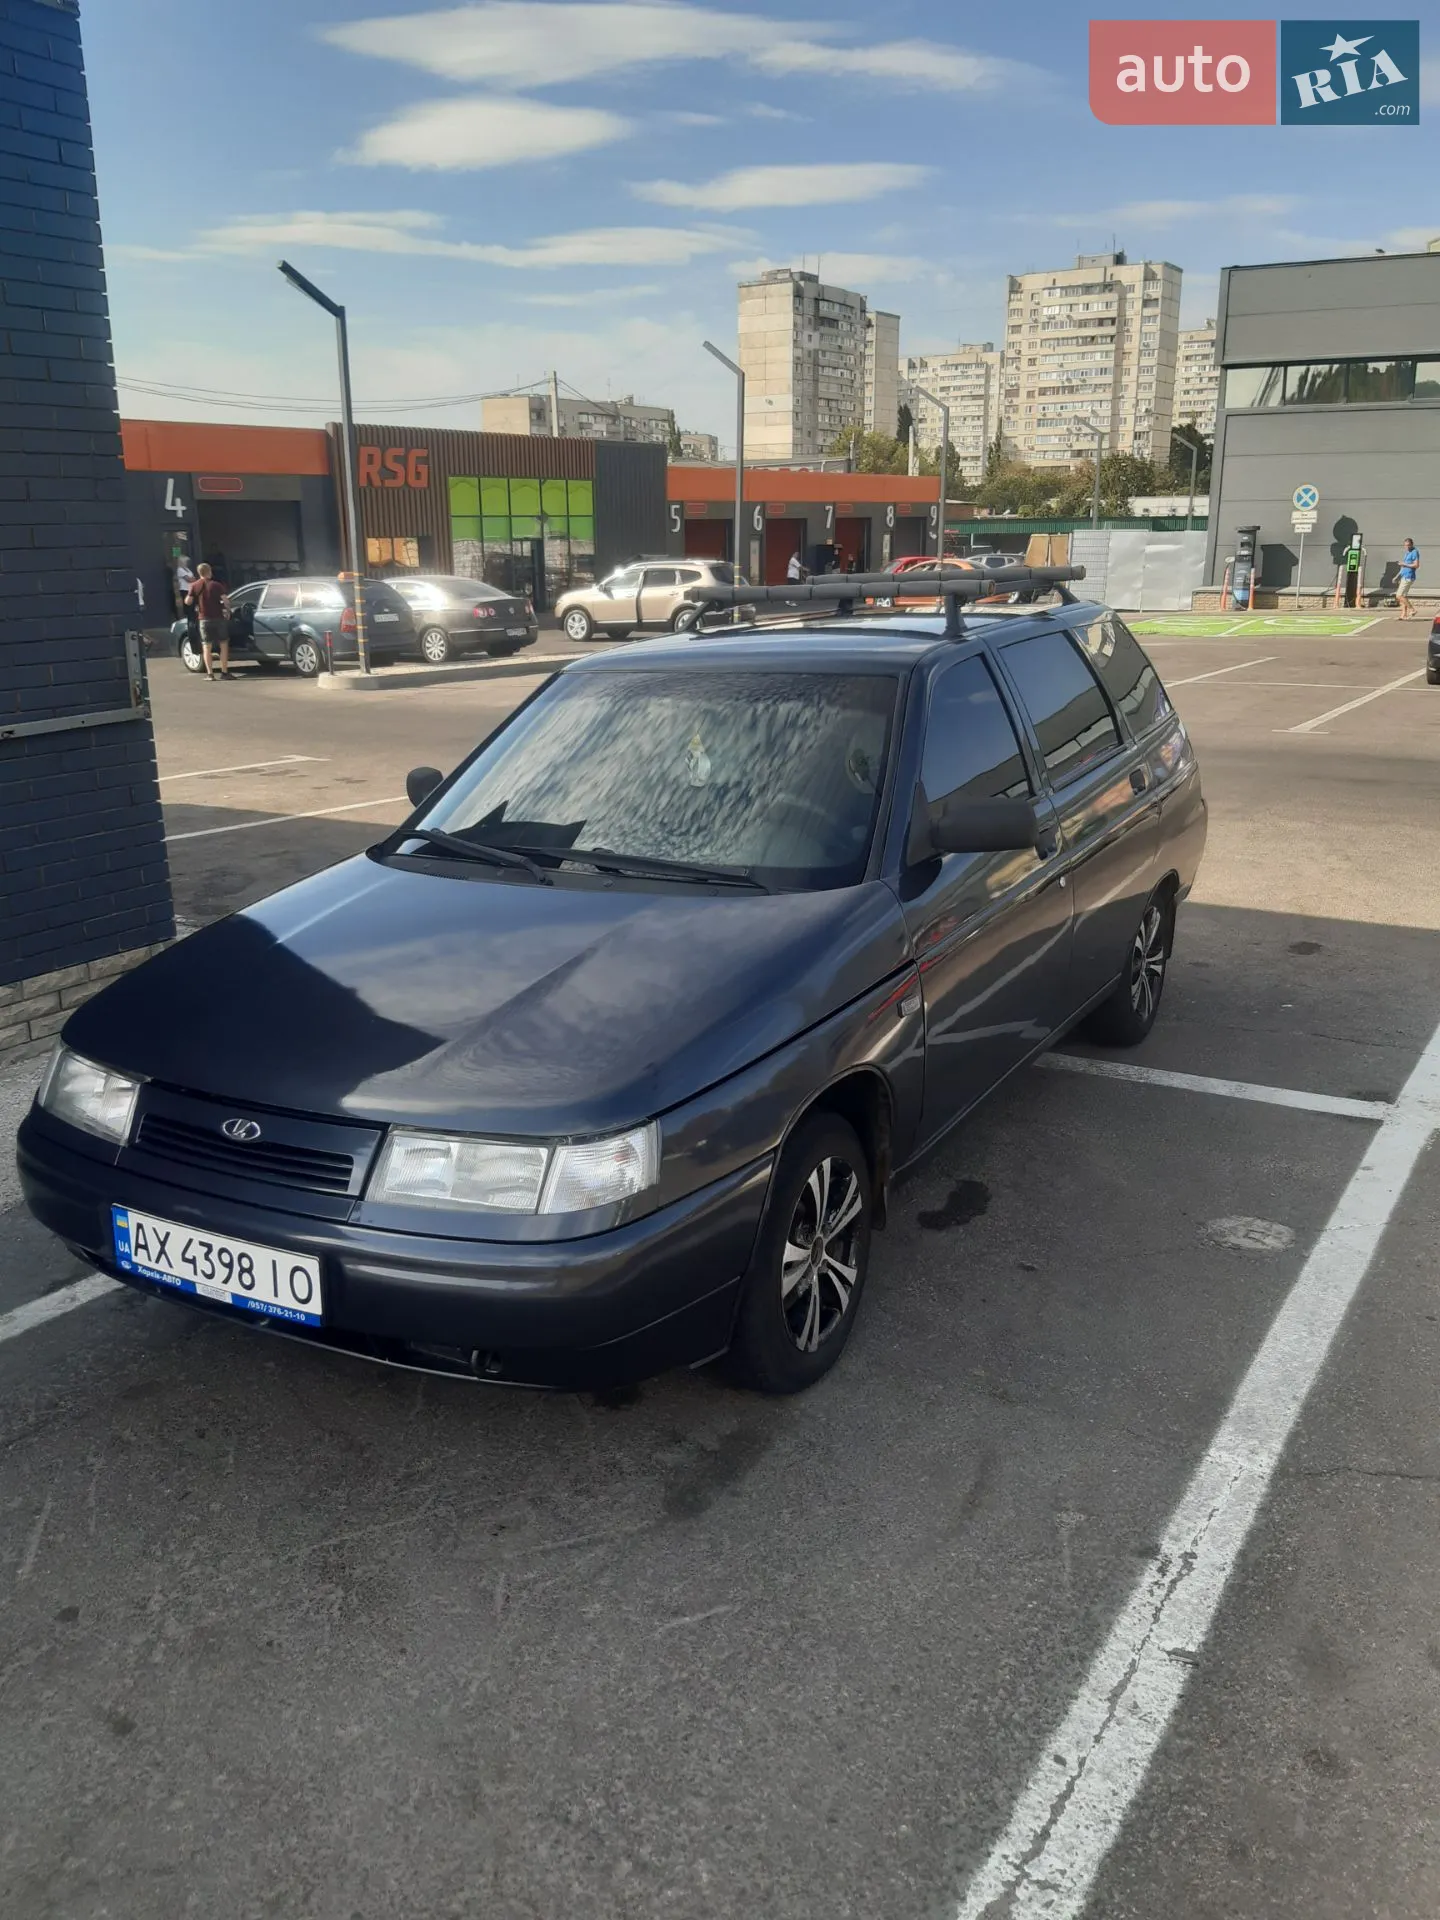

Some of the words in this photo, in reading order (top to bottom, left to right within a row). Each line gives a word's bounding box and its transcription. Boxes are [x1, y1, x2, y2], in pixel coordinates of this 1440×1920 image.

[358, 446, 430, 489] RSG
[164, 478, 187, 518] 4
[670, 504, 681, 533] 5
[752, 505, 763, 531] 6
[824, 505, 834, 529] 7
[886, 505, 895, 528] 8
[929, 505, 938, 526] 9
[118, 1239, 131, 1254] UA
[133, 1222, 174, 1269] AX
[181, 1237, 256, 1291] 4398
